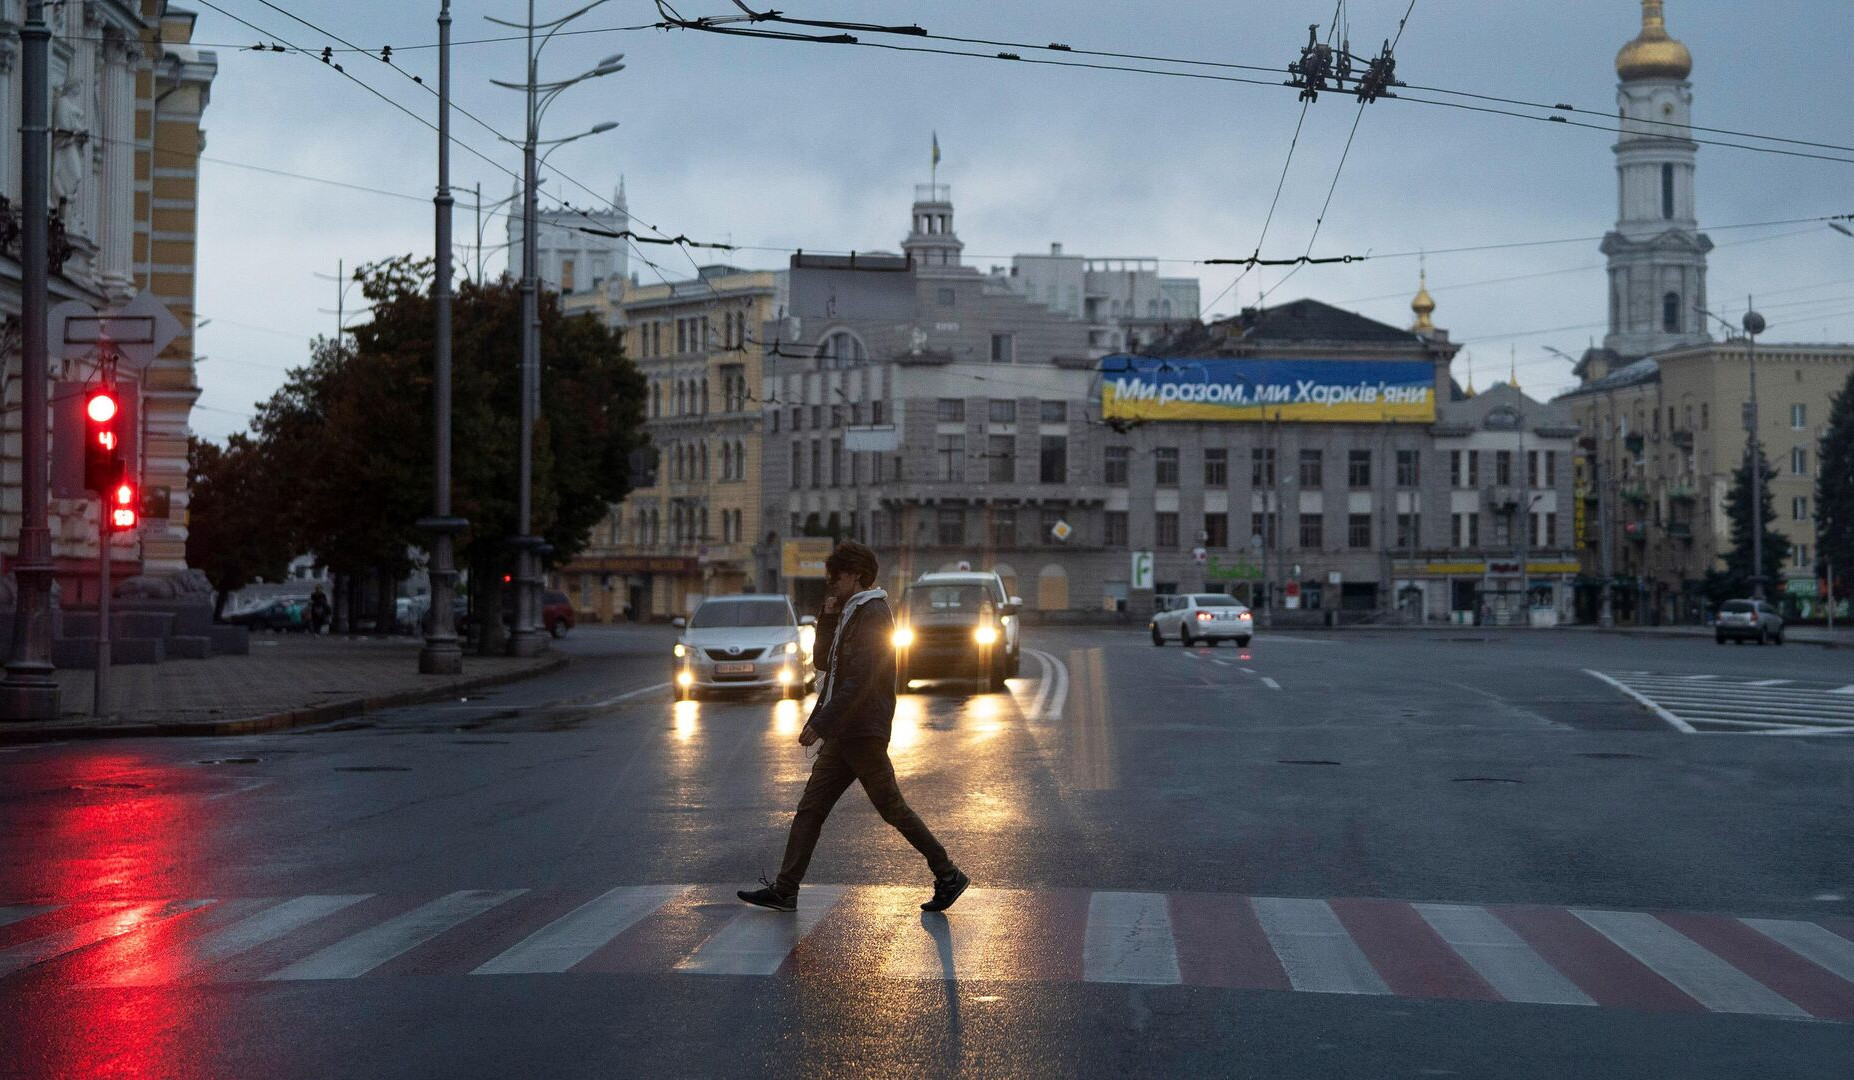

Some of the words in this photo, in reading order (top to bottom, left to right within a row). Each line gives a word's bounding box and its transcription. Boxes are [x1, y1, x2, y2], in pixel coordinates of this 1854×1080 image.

[1114, 377, 1156, 402] Ми
[1159, 382, 1248, 406] разом,
[1254, 384, 1290, 403] ми
[1295, 379, 1428, 406] Харків'яни
[98, 431, 113, 450] 4
